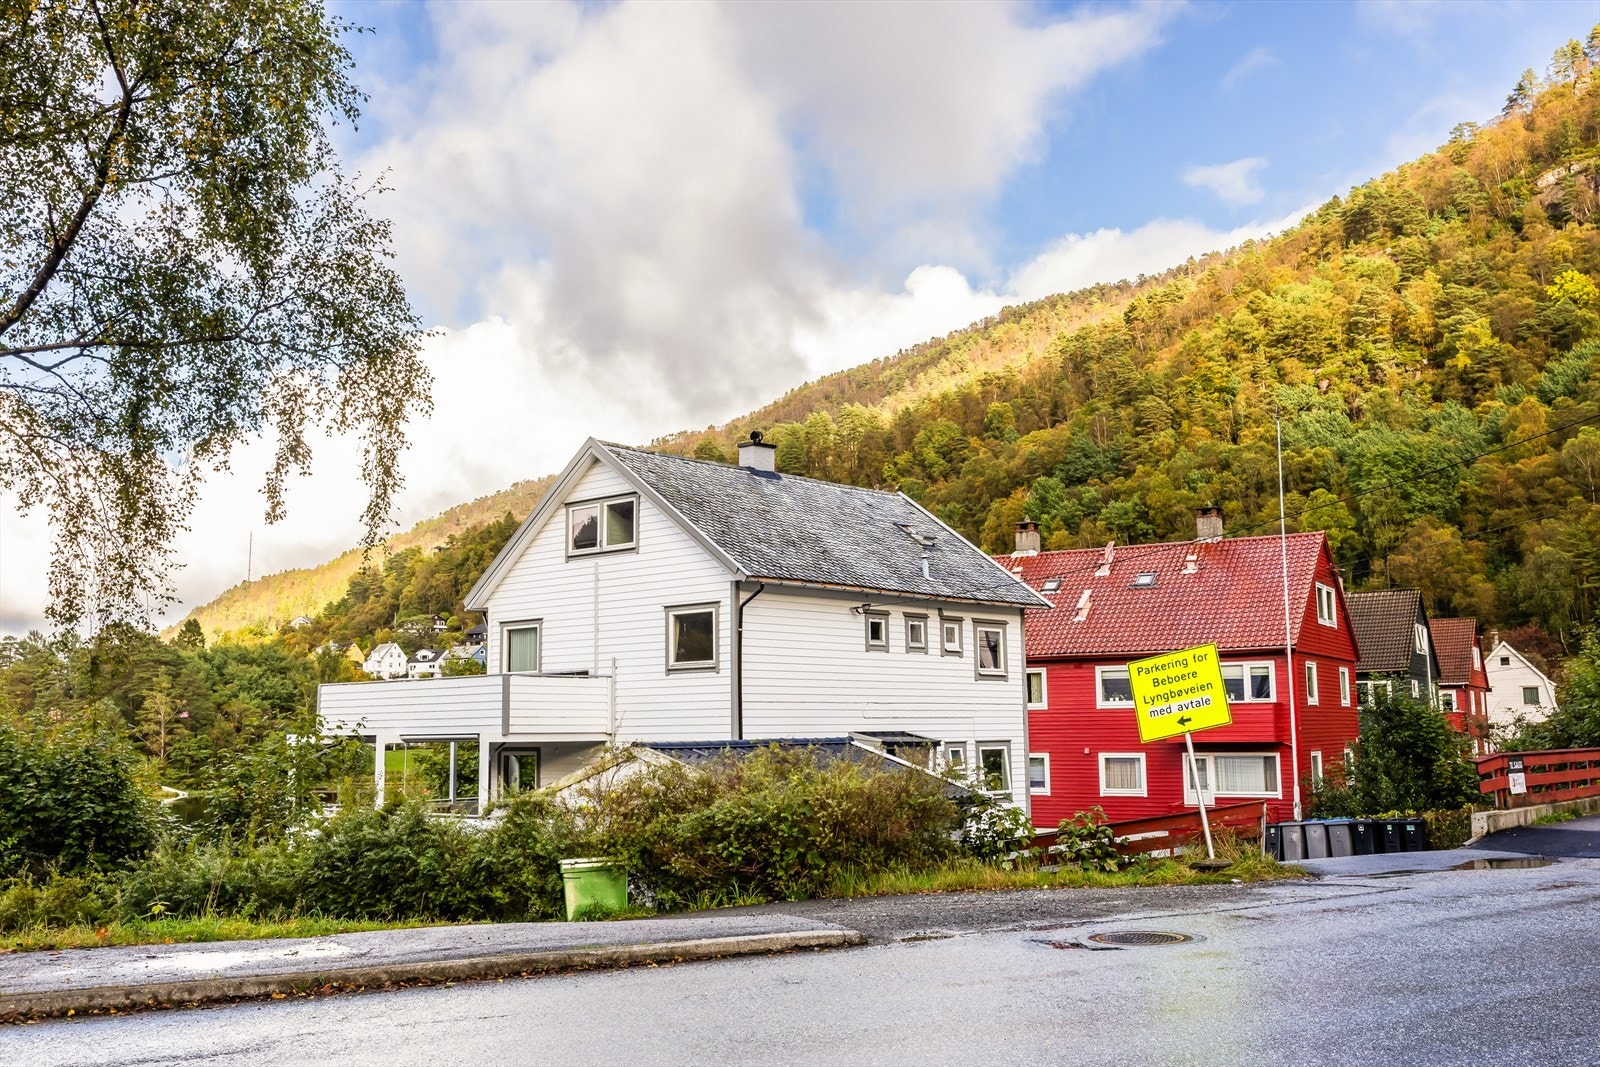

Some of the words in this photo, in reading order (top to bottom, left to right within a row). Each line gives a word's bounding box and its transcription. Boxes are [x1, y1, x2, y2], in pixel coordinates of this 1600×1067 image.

[1137, 658, 1188, 676] Parkering
[1193, 653, 1208, 663] for
[1152, 671, 1198, 687] Beboere
[1143, 682, 1213, 705] Lyngbøveien
[1149, 705, 1172, 718] med
[1177, 697, 1211, 711] avtale
